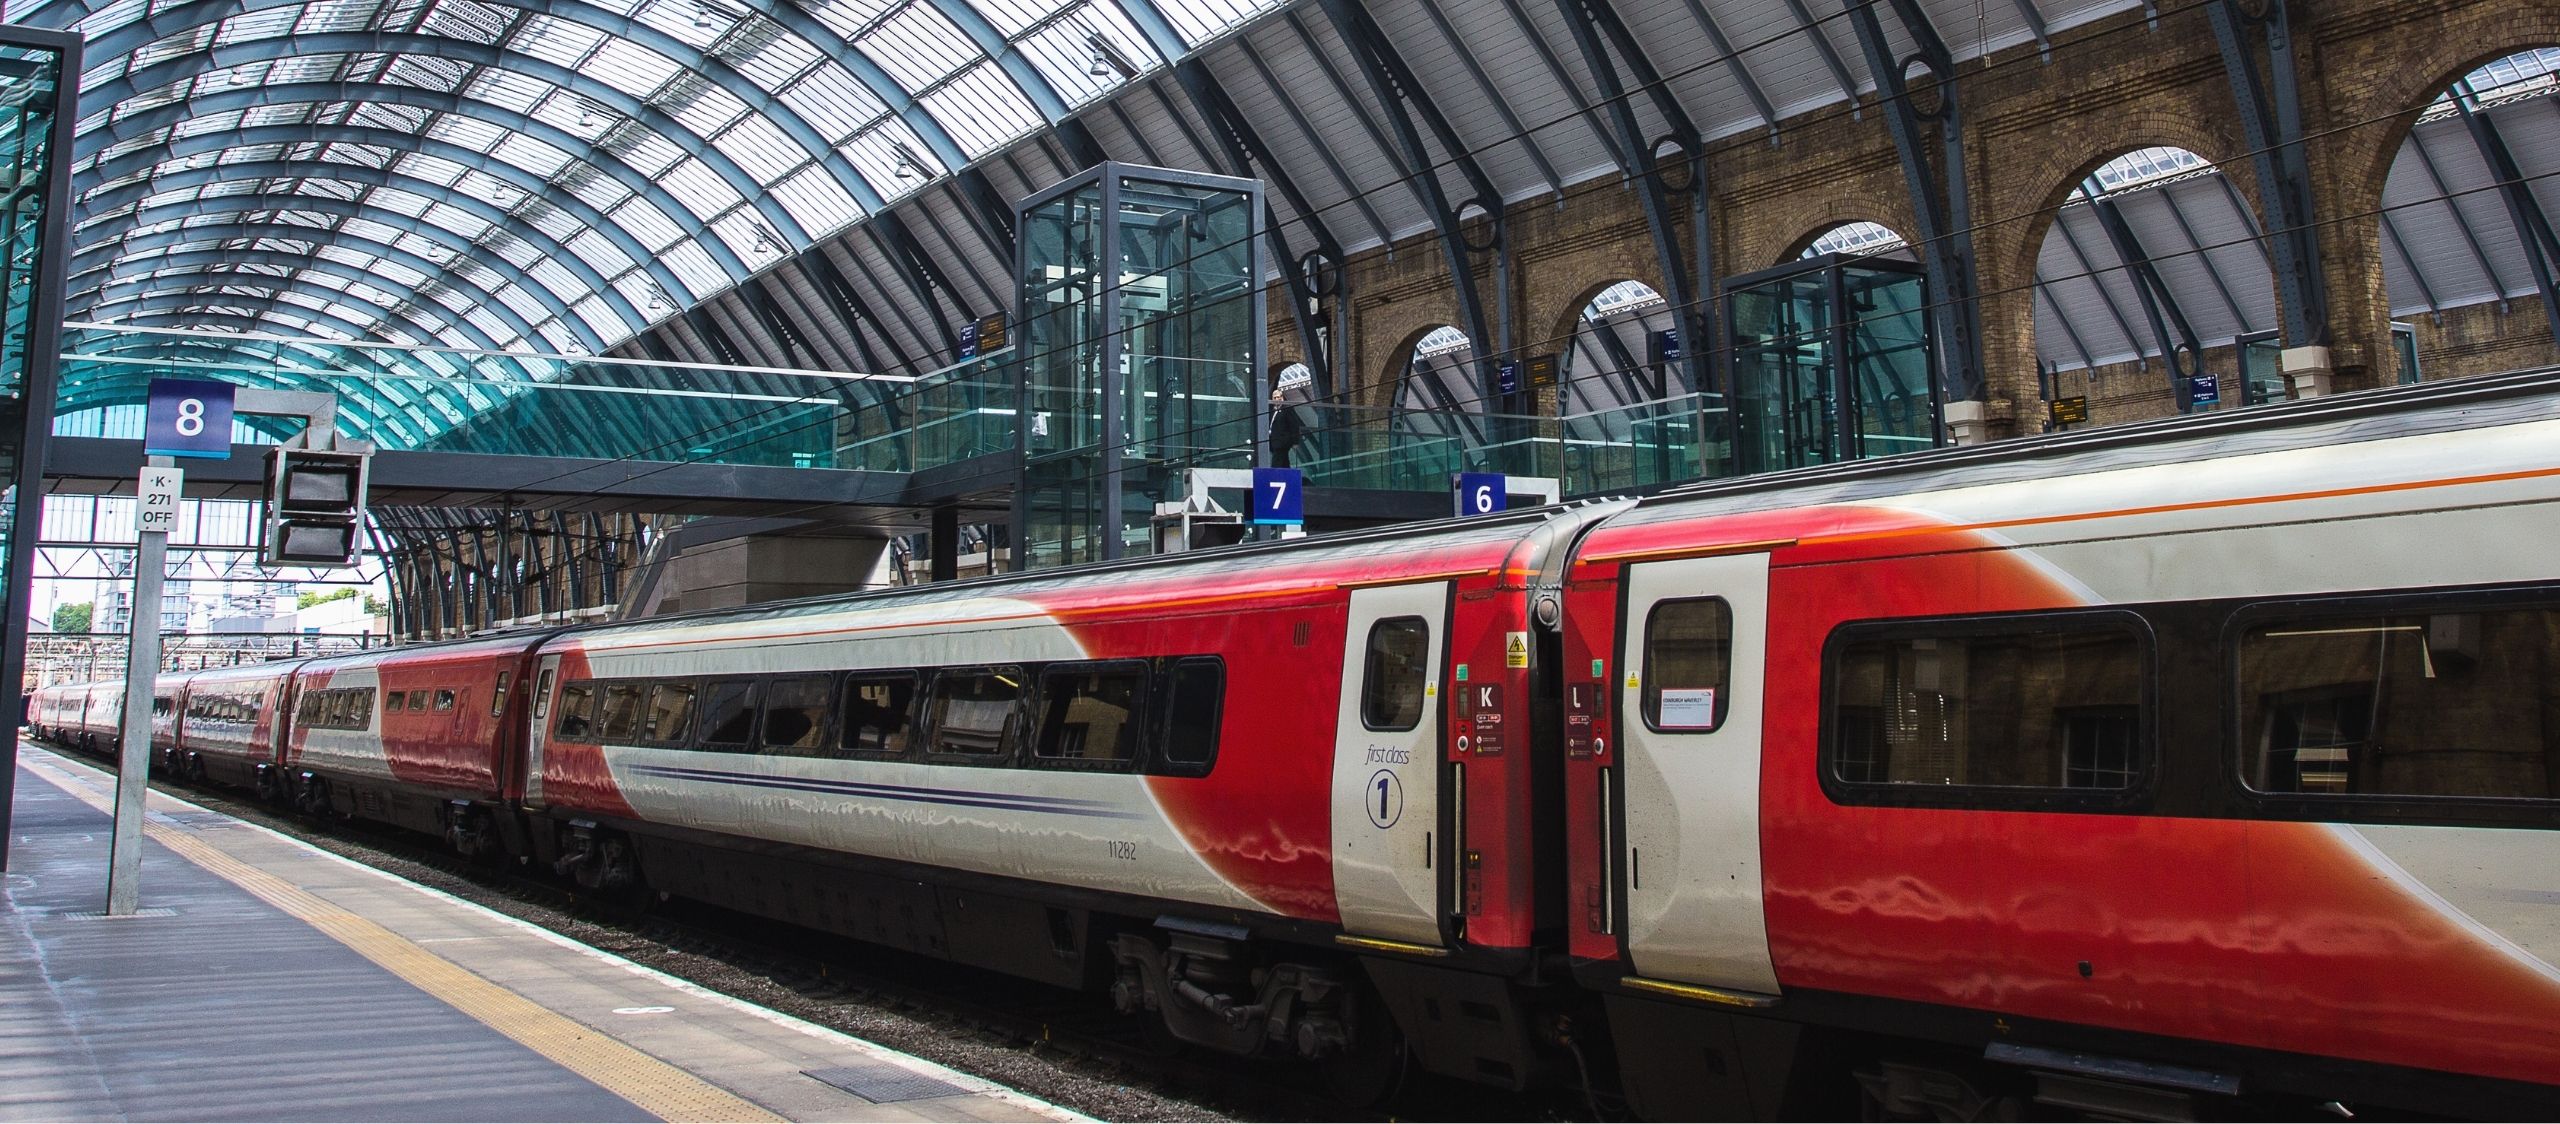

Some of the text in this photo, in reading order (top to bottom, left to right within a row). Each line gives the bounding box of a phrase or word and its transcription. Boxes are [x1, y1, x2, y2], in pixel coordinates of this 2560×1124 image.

[176, 398, 205, 437] 8
[155, 476, 165, 487] K
[148, 493, 171, 505] 271
[1269, 481, 1287, 510] 7
[1476, 485, 1491, 513] 6
[143, 511, 173, 523] OFF
[1481, 687, 1493, 707] K
[1572, 687, 1581, 708] L
[1365, 744, 1410, 766] first class
[1377, 778, 1389, 820] 1
[1109, 840, 1137, 860] 11282
